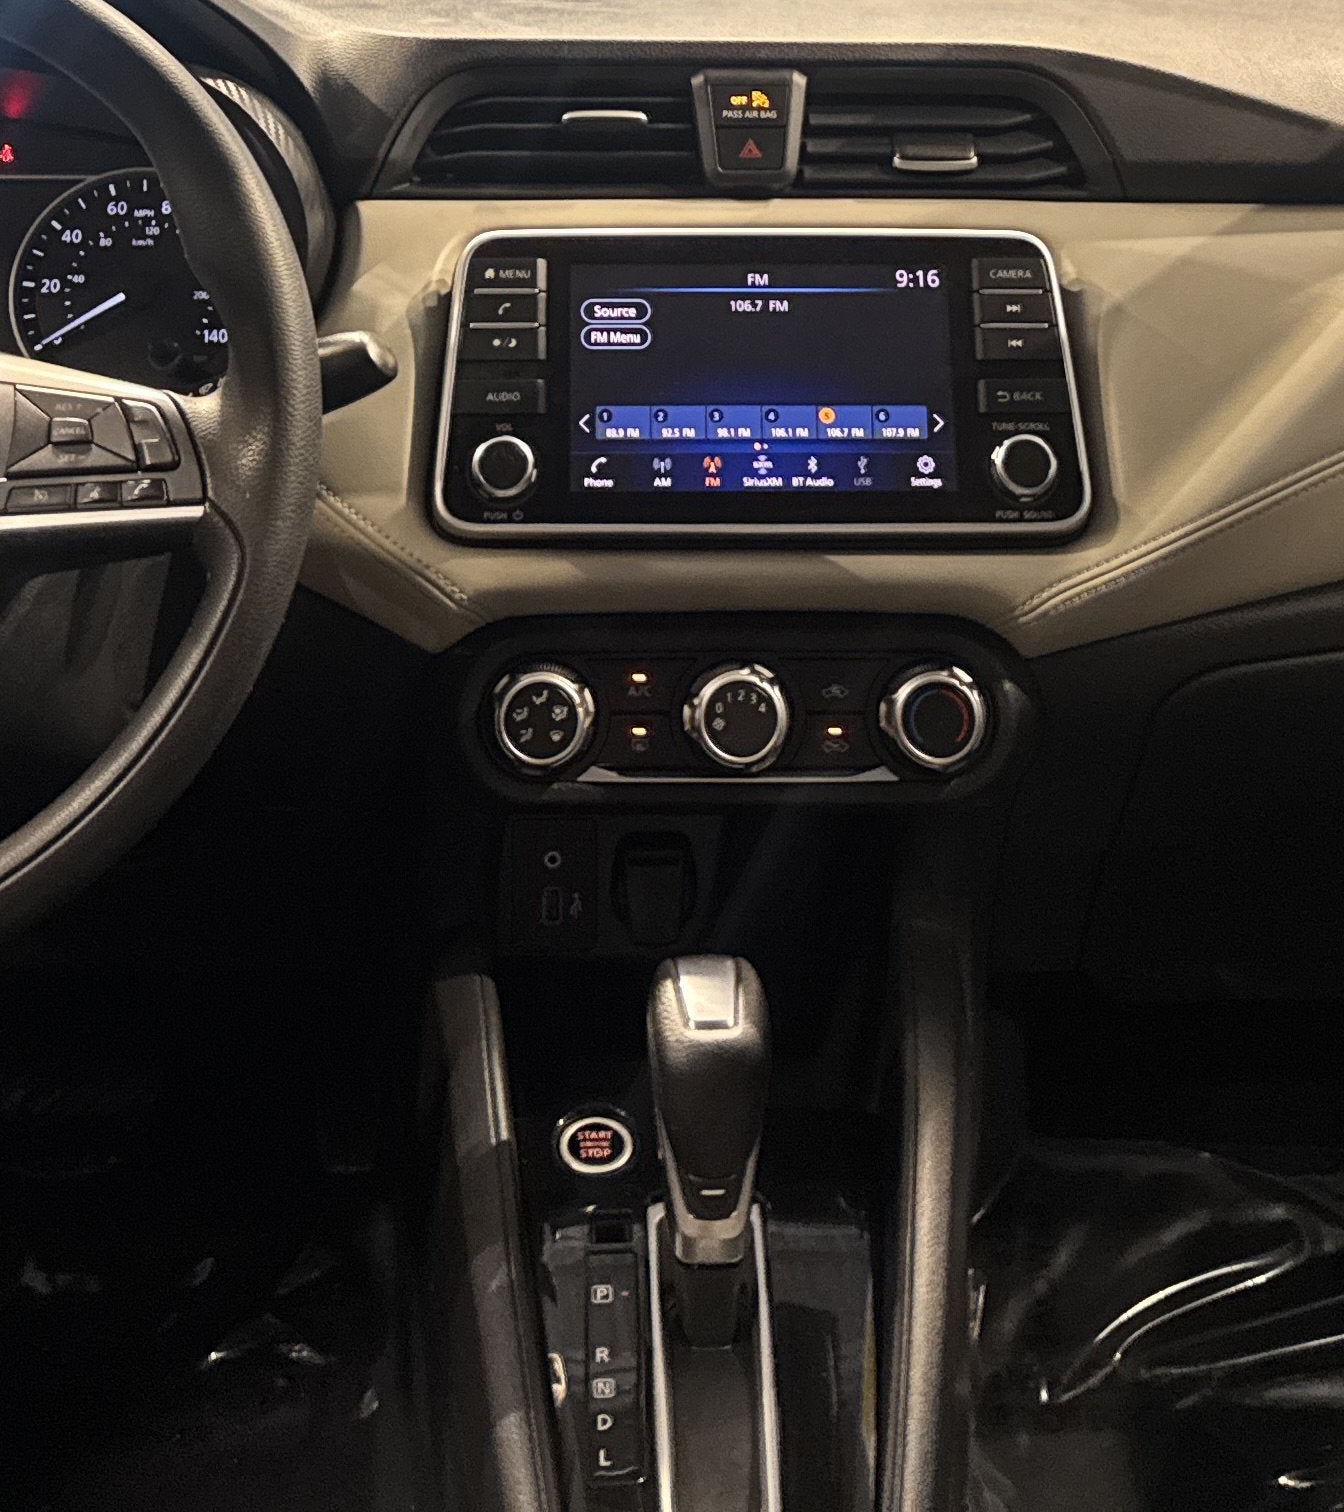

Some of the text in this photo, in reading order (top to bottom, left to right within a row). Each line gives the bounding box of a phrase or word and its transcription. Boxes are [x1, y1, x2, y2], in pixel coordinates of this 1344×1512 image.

[722, 109, 777, 120] PASS AIR BAG
[106, 201, 128, 216] 60
[133, 208, 155, 218] MPH
[161, 200, 172, 215] 8
[61, 228, 83, 244] 40
[498, 269, 532, 279] MENU
[746, 273, 769, 286] FM
[894, 269, 940, 289] 9:16
[989, 268, 1032, 280] CAMERA
[40, 279, 61, 294] 20
[593, 304, 638, 319] Source
[729, 299, 789, 313] 106.7 FM
[202, 328, 229, 344] 140
[589, 331, 641, 345] FM Menu
[486, 391, 521, 402] AUDIO
[1012, 391, 1043, 402] BACK
[627, 427, 640, 438] FM
[682, 427, 696, 438] FM
[738, 427, 751, 438] FM
[795, 427, 809, 438] FM
[850, 427, 864, 438] FM
[906, 427, 920, 438] FM
[583, 477, 615, 488] Phone
[653, 477, 672, 487] AM
[704, 477, 721, 487] FM
[742, 476, 783, 487] SiriusXM
[791, 476, 835, 487] BT Audio
[910, 476, 943, 489] Settings
[727, 691, 733, 703] 1
[737, 689, 746, 701] 2
[749, 692, 758, 705] 3
[714, 701, 724, 714] 0
[758, 702, 766, 714] 4
[577, 1130, 613, 1140] START
[579, 1148, 613, 1159] STOP
[595, 1287, 607, 1301] P
[595, 1346, 610, 1364] R
[597, 1381, 610, 1395] N
[596, 1413, 613, 1431] D
[598, 1448, 613, 1467] L
